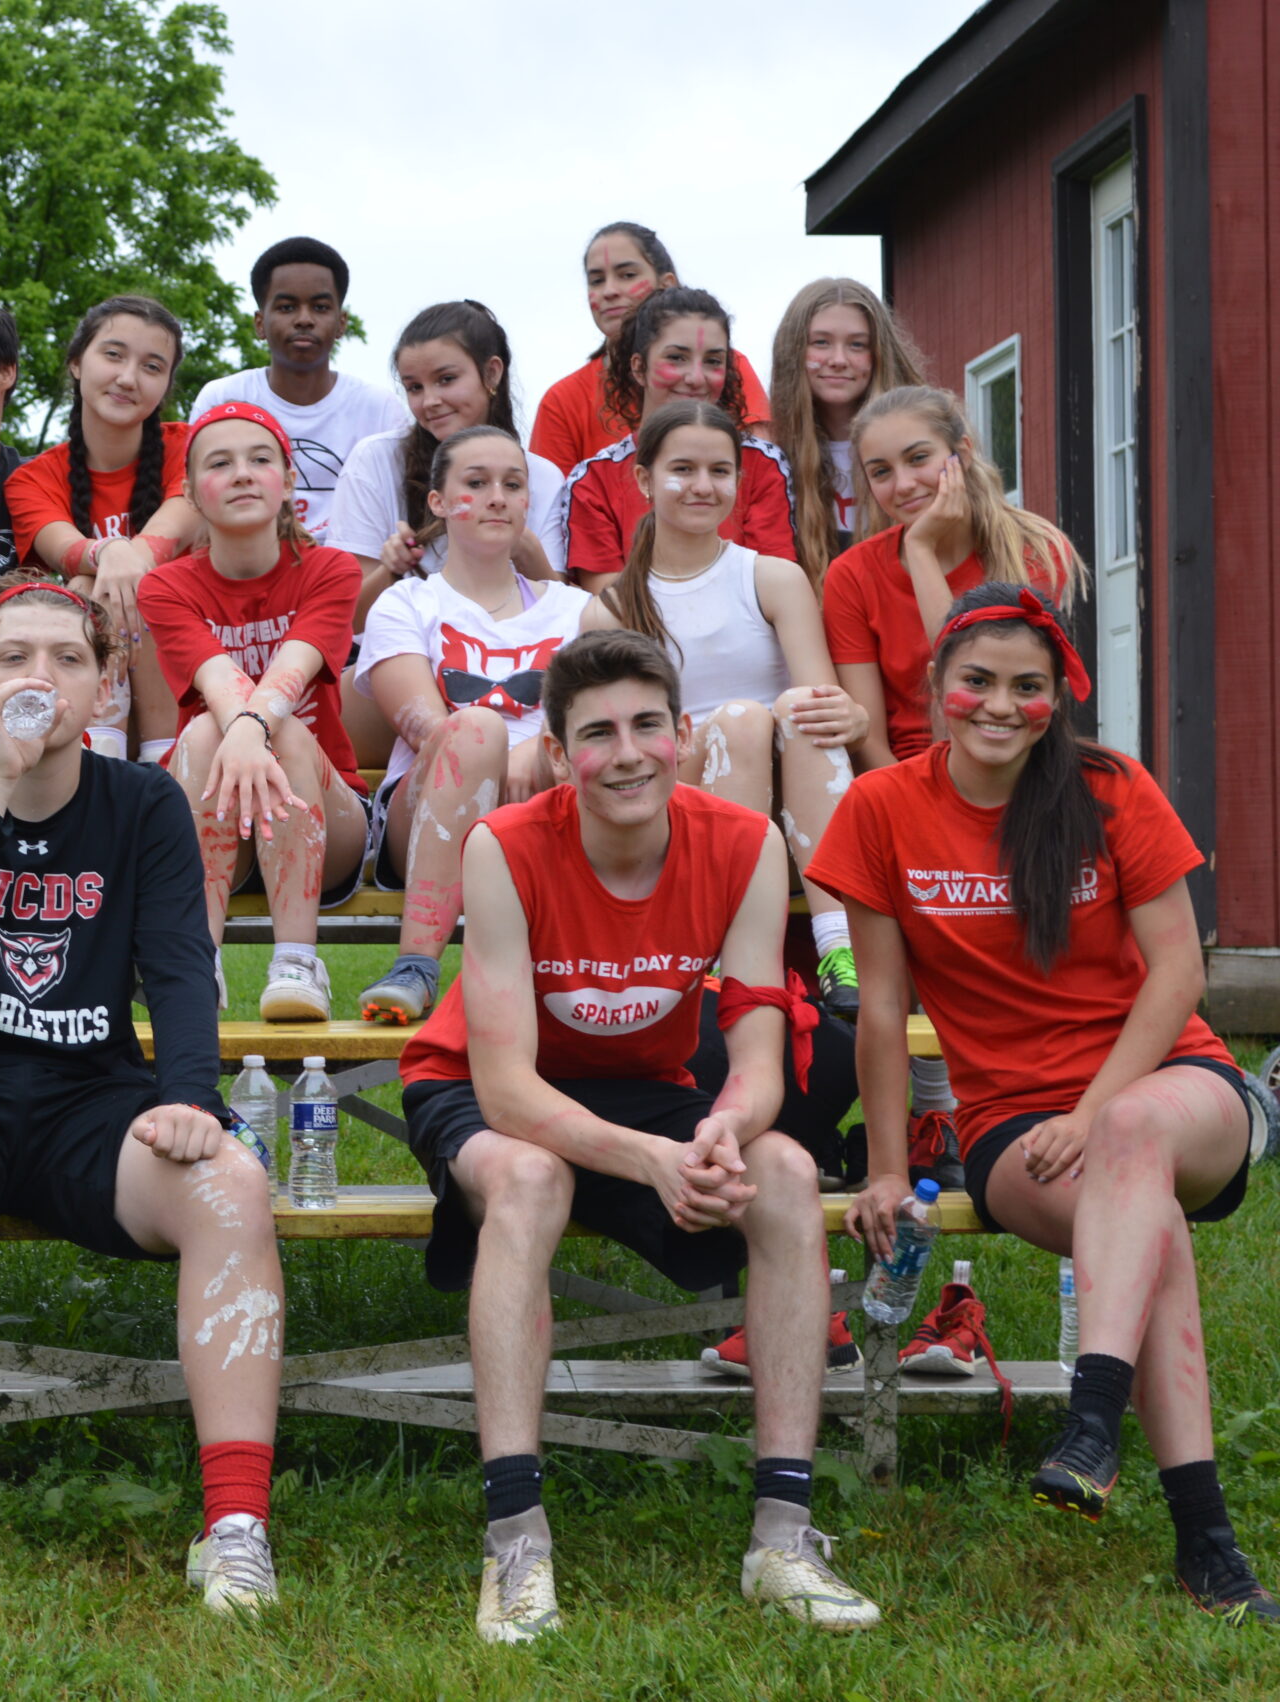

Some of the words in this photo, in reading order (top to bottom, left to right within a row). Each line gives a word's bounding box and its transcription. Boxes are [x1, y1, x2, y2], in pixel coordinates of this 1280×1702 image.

[907, 869, 950, 881] YOU'RE
[951, 870, 964, 880] IN
[633, 955, 673, 972] DAY
[571, 1000, 659, 1026] SPARTAN
[313, 1107, 336, 1115] DEER
